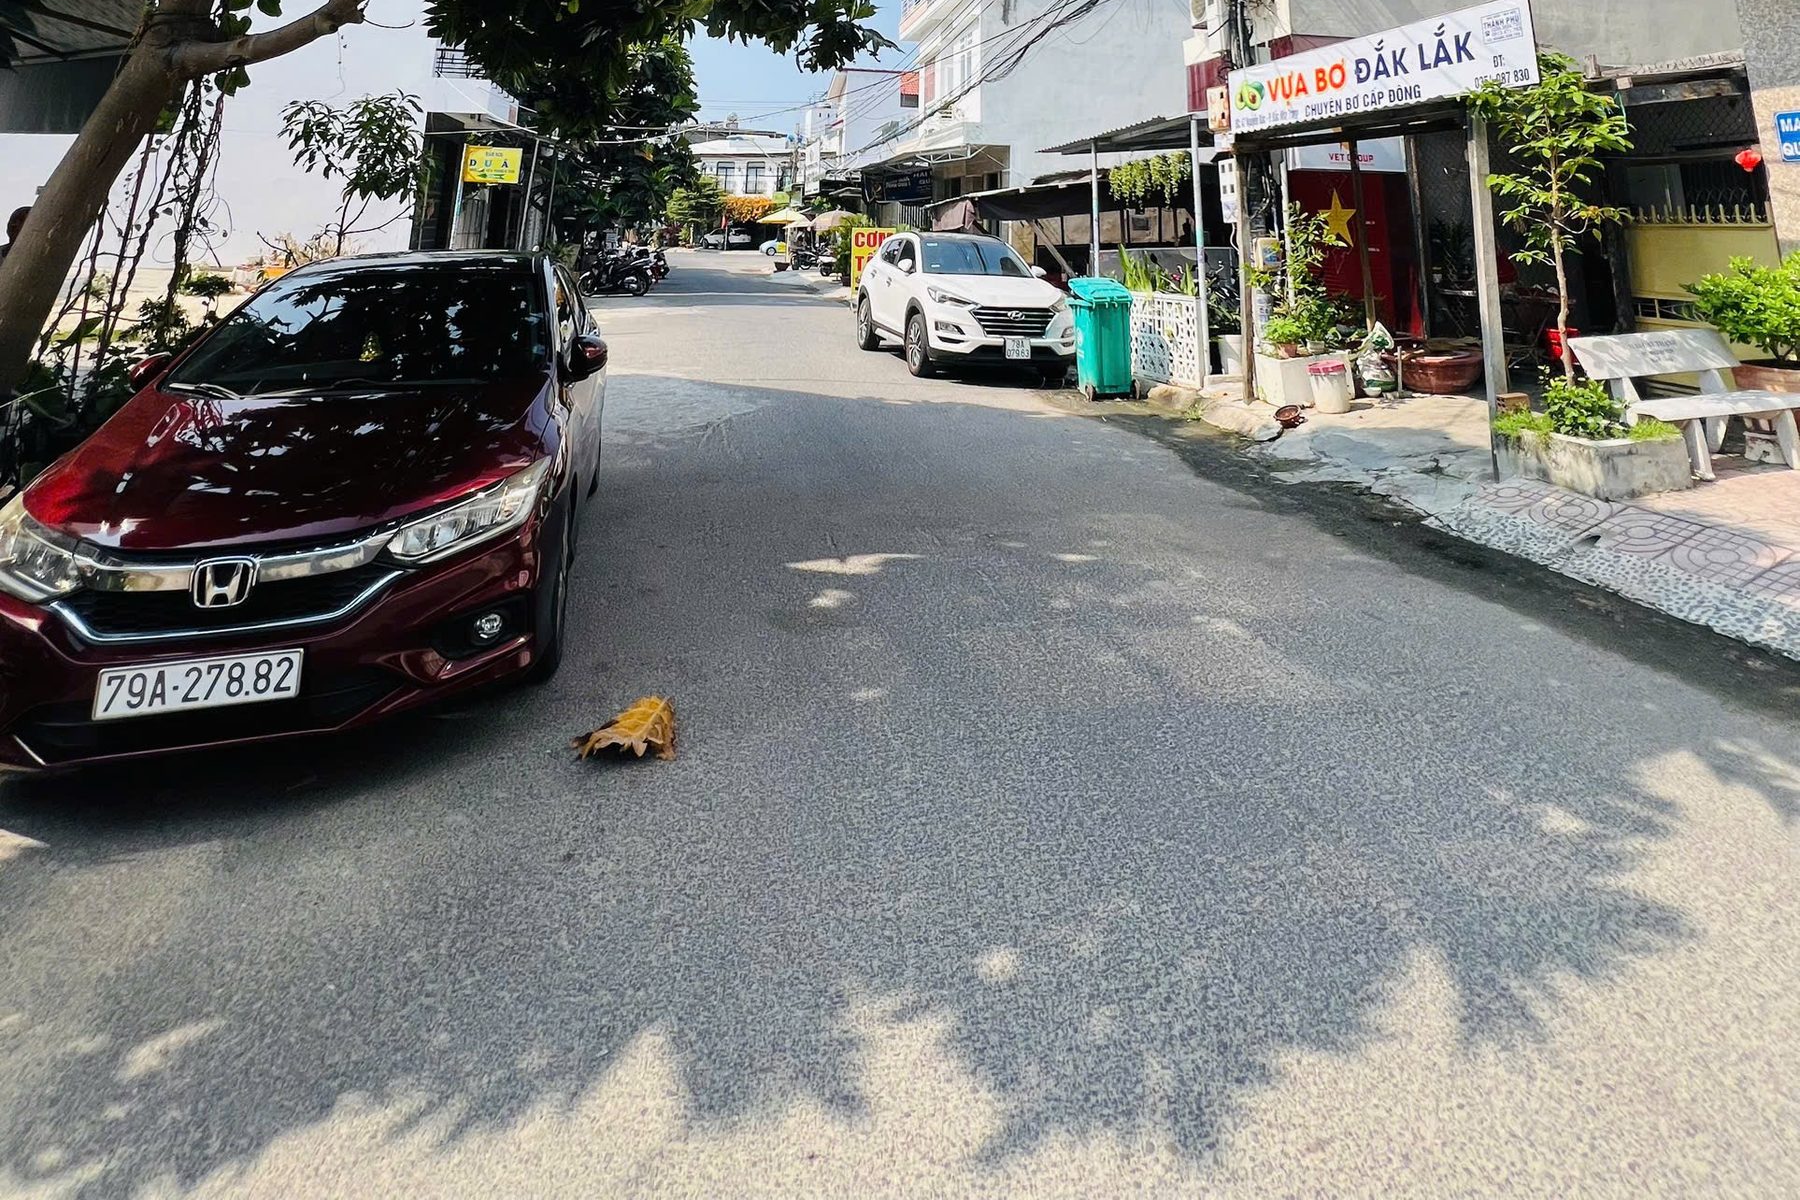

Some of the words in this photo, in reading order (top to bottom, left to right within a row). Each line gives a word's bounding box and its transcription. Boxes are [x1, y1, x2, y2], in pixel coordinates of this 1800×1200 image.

[1266, 71, 1308, 106] VỰA
[1315, 58, 1346, 92] BƠ
[1355, 37, 1410, 84] ĐẮK
[1418, 22, 1475, 71] LẮK
[1514, 68, 1530, 83] 830
[1305, 97, 1342, 117] CHUYÊN
[1346, 94, 1360, 111] BƠ
[1388, 84, 1421, 103] ĐÔNG
[1328, 153, 1345, 161] VET
[103, 657, 294, 713] 79A-278.82
